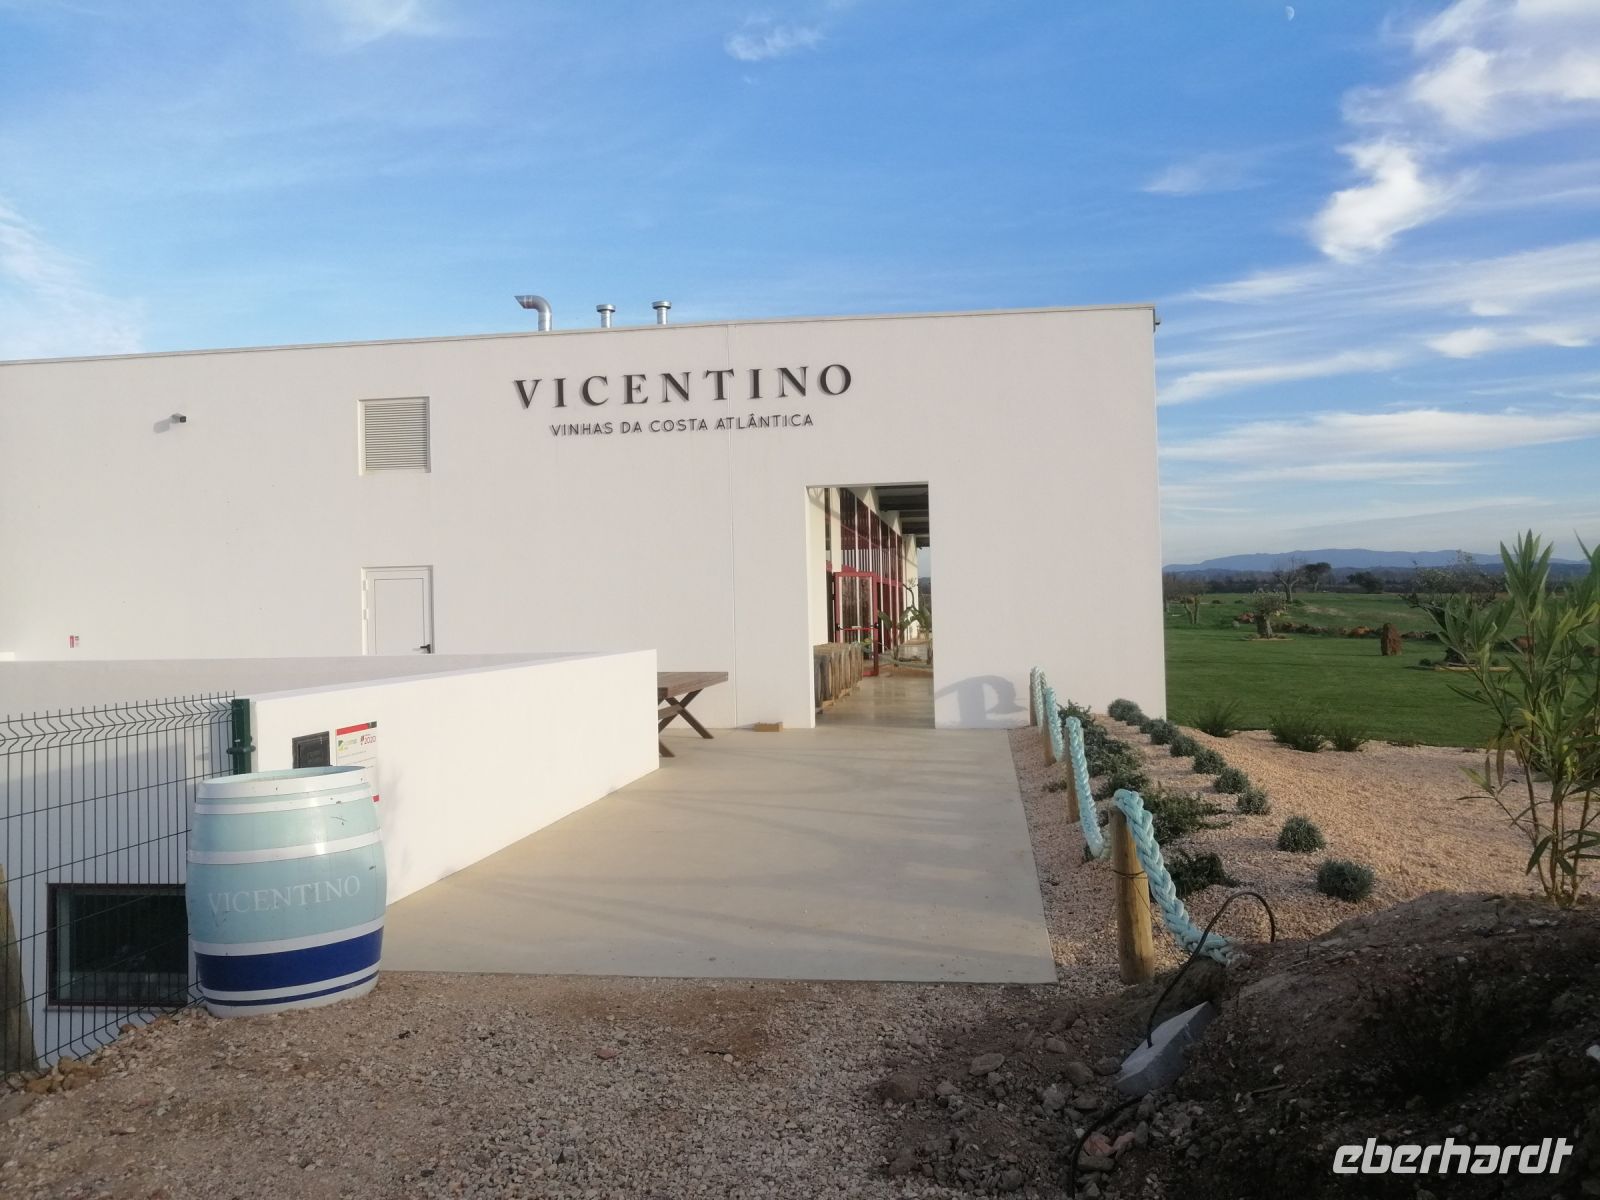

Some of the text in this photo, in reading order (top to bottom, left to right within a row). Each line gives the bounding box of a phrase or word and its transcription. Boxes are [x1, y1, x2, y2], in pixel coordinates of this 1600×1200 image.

[513, 364, 851, 409] VICENTINO
[551, 413, 813, 436] VINHAS DA COSTA ATLÂNTICA
[209, 876, 361, 914] VICENTINO
